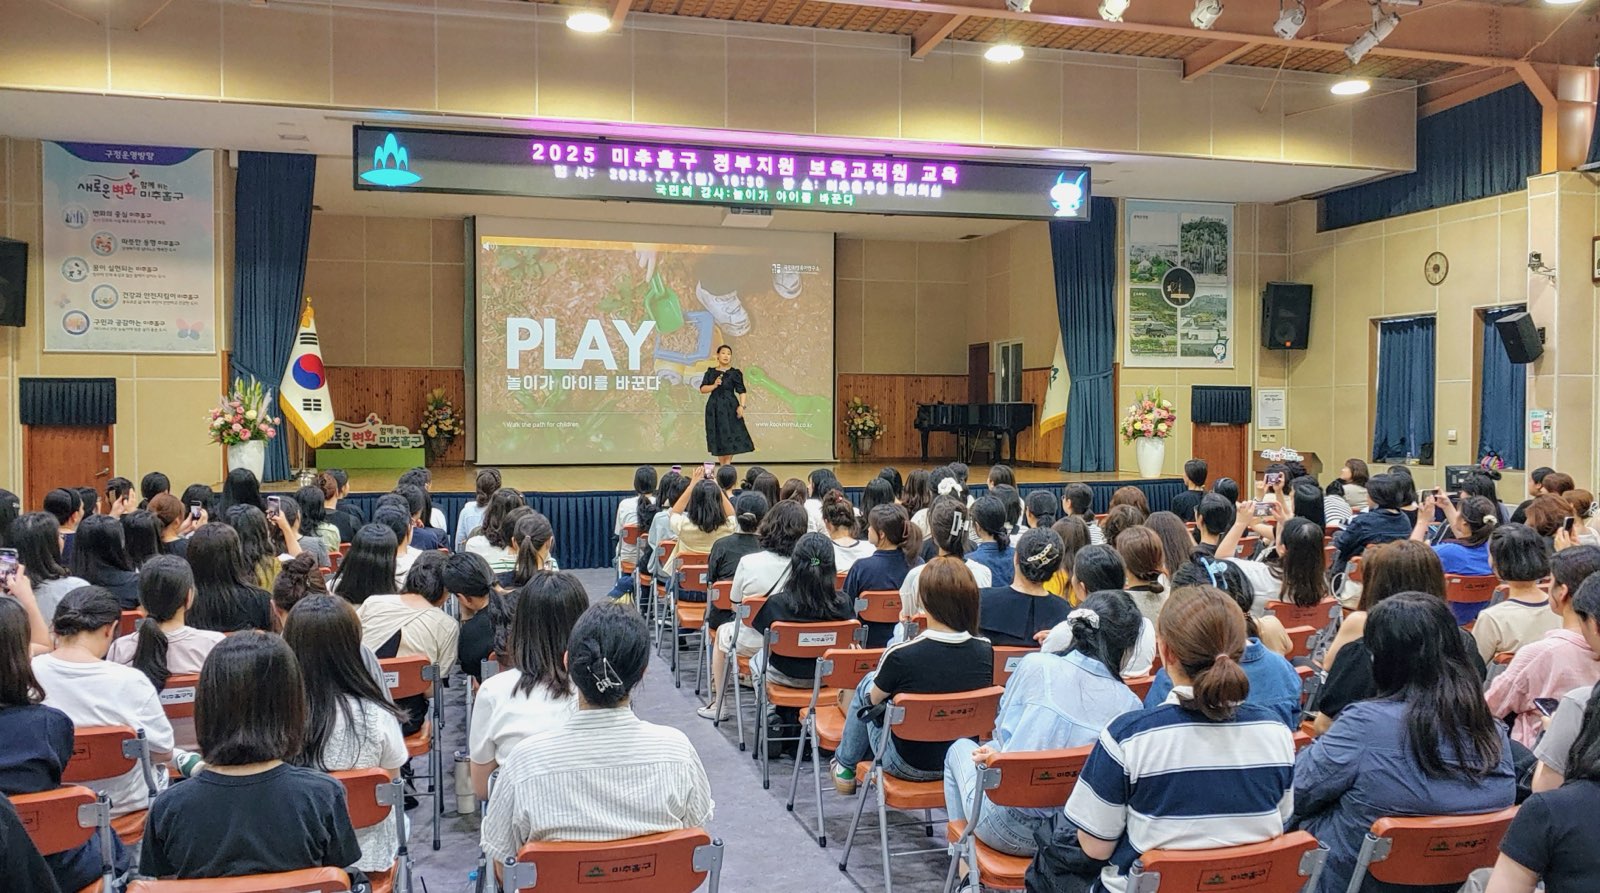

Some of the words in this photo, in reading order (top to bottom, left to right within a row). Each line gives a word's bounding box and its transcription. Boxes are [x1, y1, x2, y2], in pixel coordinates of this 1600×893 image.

[105, 150, 155, 161] 구정운영방향
[532, 143, 596, 163] 2025
[611, 147, 698, 170] 미추홀구
[713, 153, 795, 176] 정부지원
[809, 160, 908, 182] 보육교직원
[921, 166, 958, 184] 교육
[77, 179, 111, 199] 새로운
[112, 182, 138, 200] 변화
[140, 181, 155, 190] 함께
[140, 190, 184, 202] 미추홀구
[776, 190, 812, 204] 아이를
[819, 192, 854, 206] 바꾼다
[506, 317, 657, 371] PLAY
[507, 375, 554, 391] 놀이가
[562, 375, 608, 391] 아이를
[616, 375, 661, 391] 바꾼다
[379, 426, 393, 435] 함께
[352, 429, 377, 447] 변화
[379, 436, 421, 446] 미추홀구
[611, 862, 651, 873] 미추홀구
